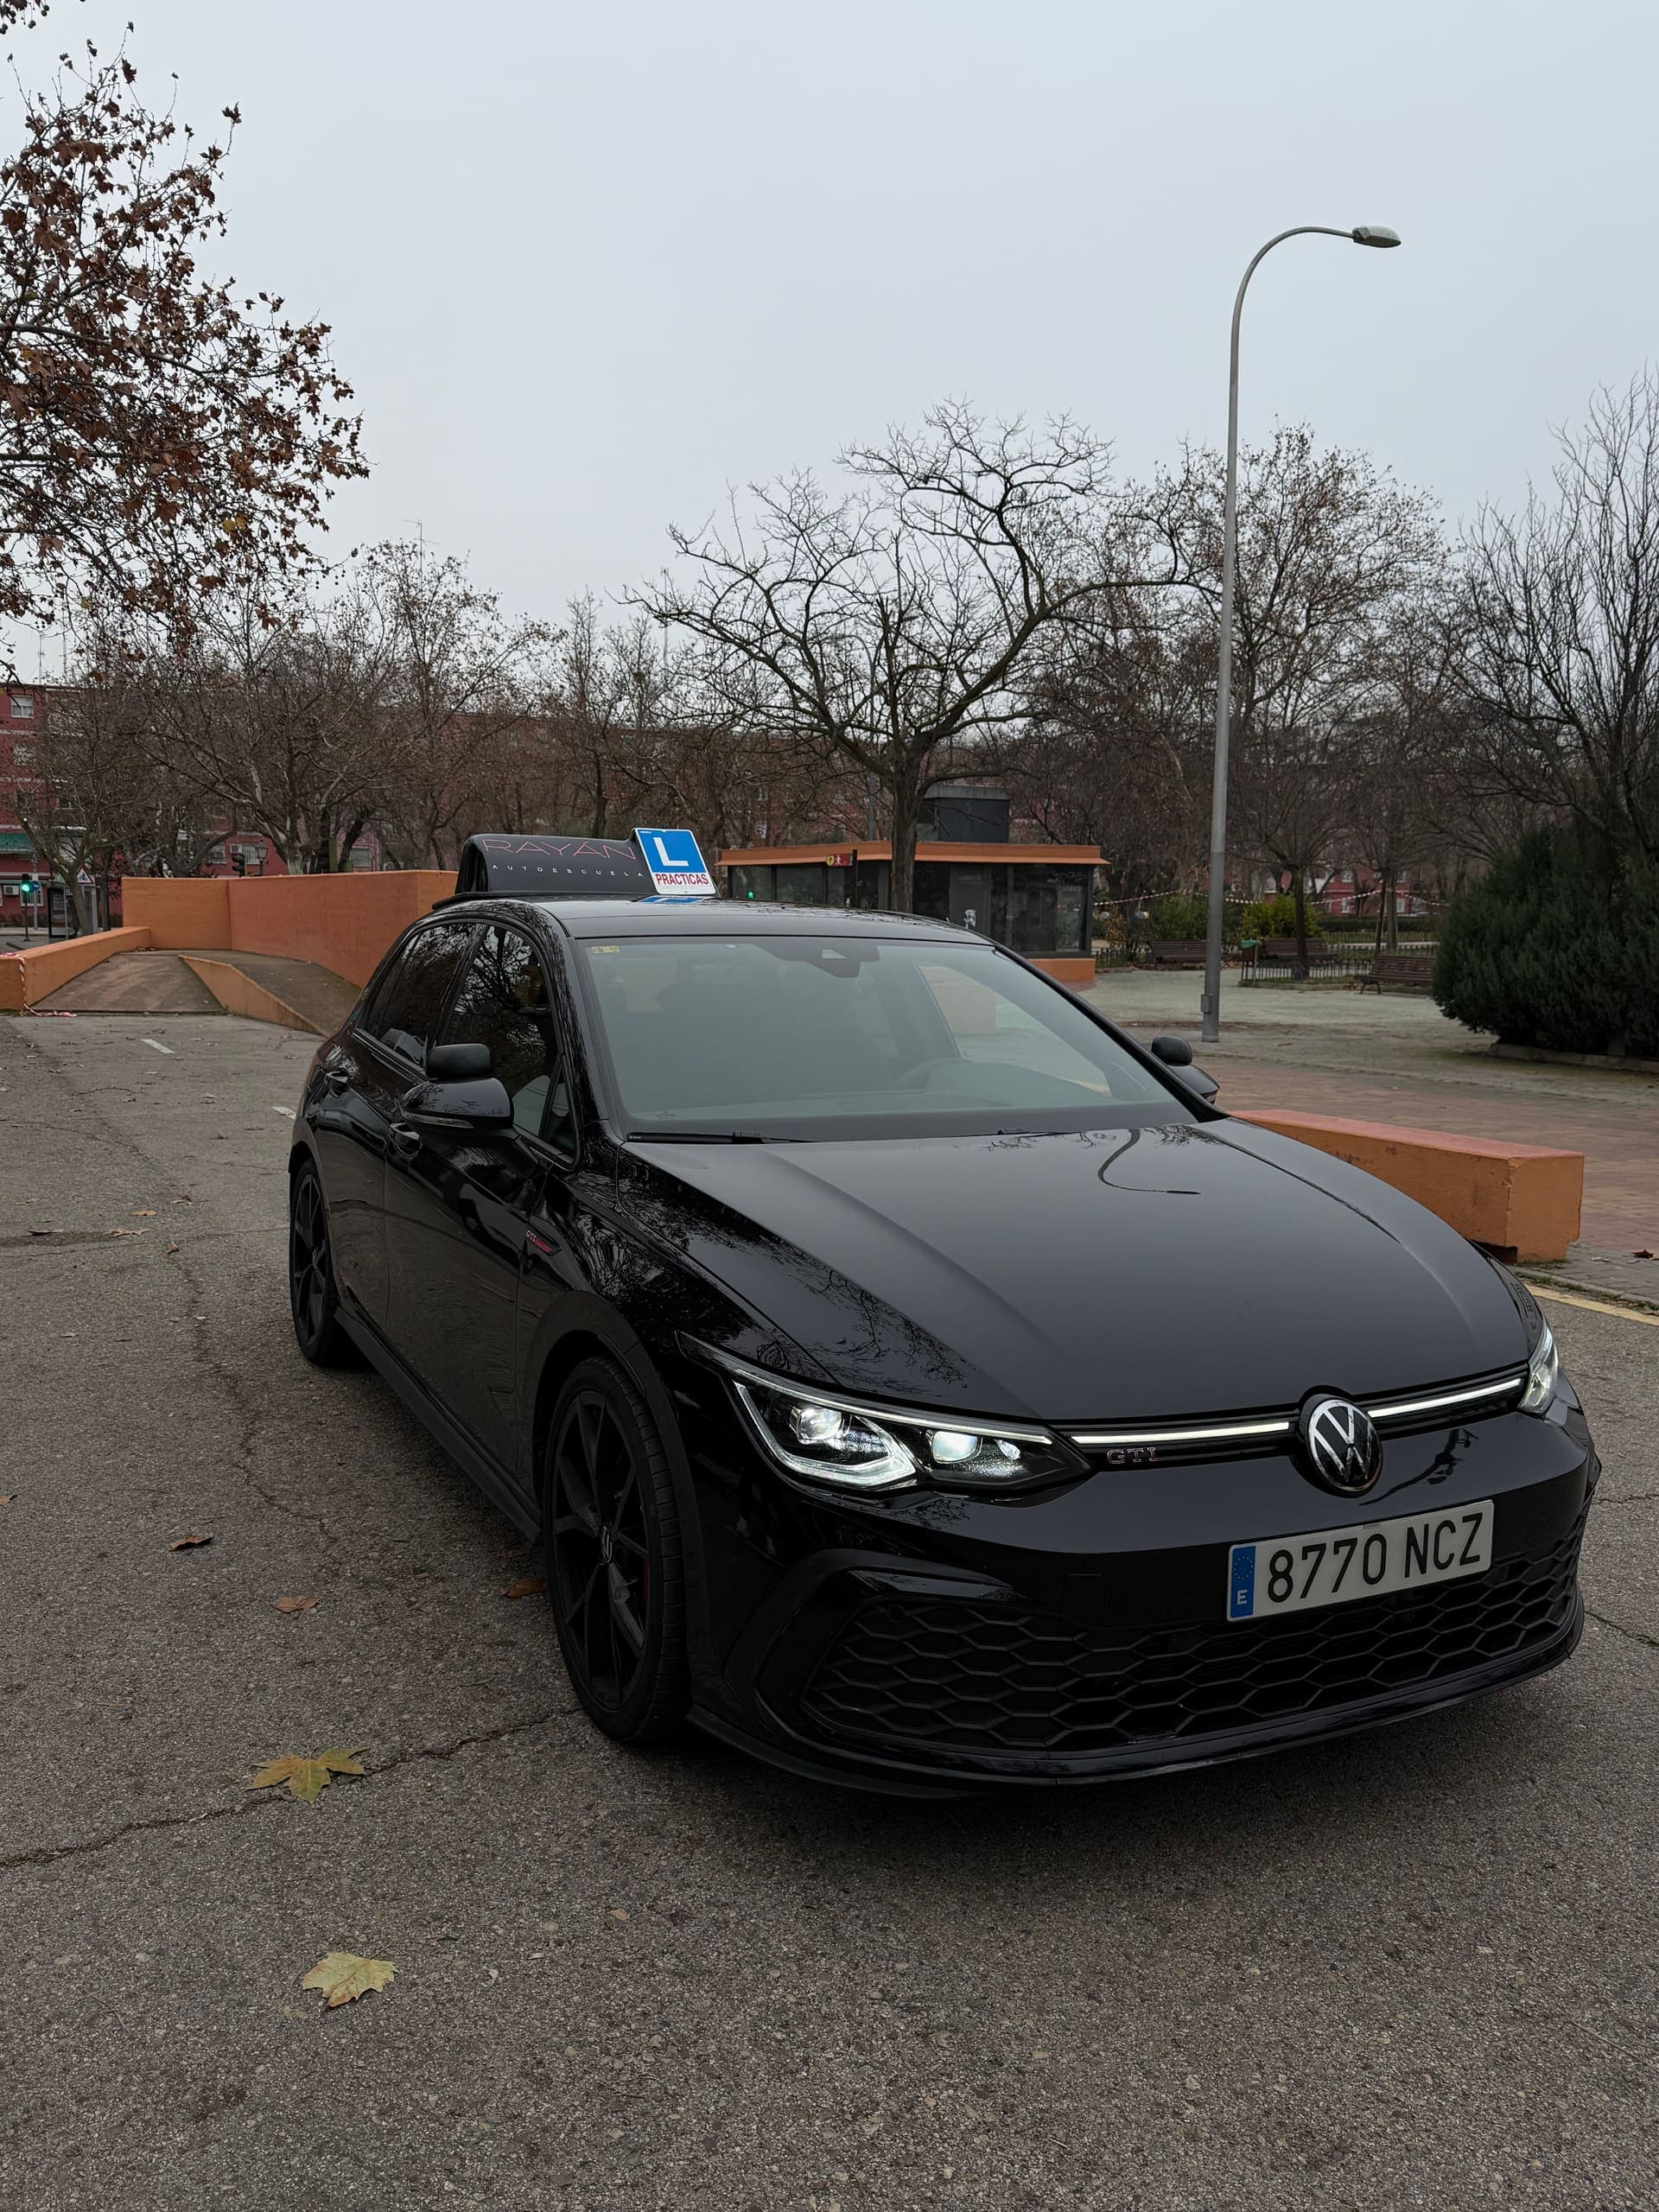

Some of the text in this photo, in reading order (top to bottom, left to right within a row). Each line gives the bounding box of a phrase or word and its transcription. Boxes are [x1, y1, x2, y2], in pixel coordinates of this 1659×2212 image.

[653, 837, 690, 867] L
[492, 864, 644, 878] AUTOESCUELA
[655, 874, 709, 886] PRACTICAS
[1107, 1446, 1158, 1465] GTI
[1268, 1512, 1484, 1603] 8770 NCZ
[1236, 1589, 1249, 1605] E
